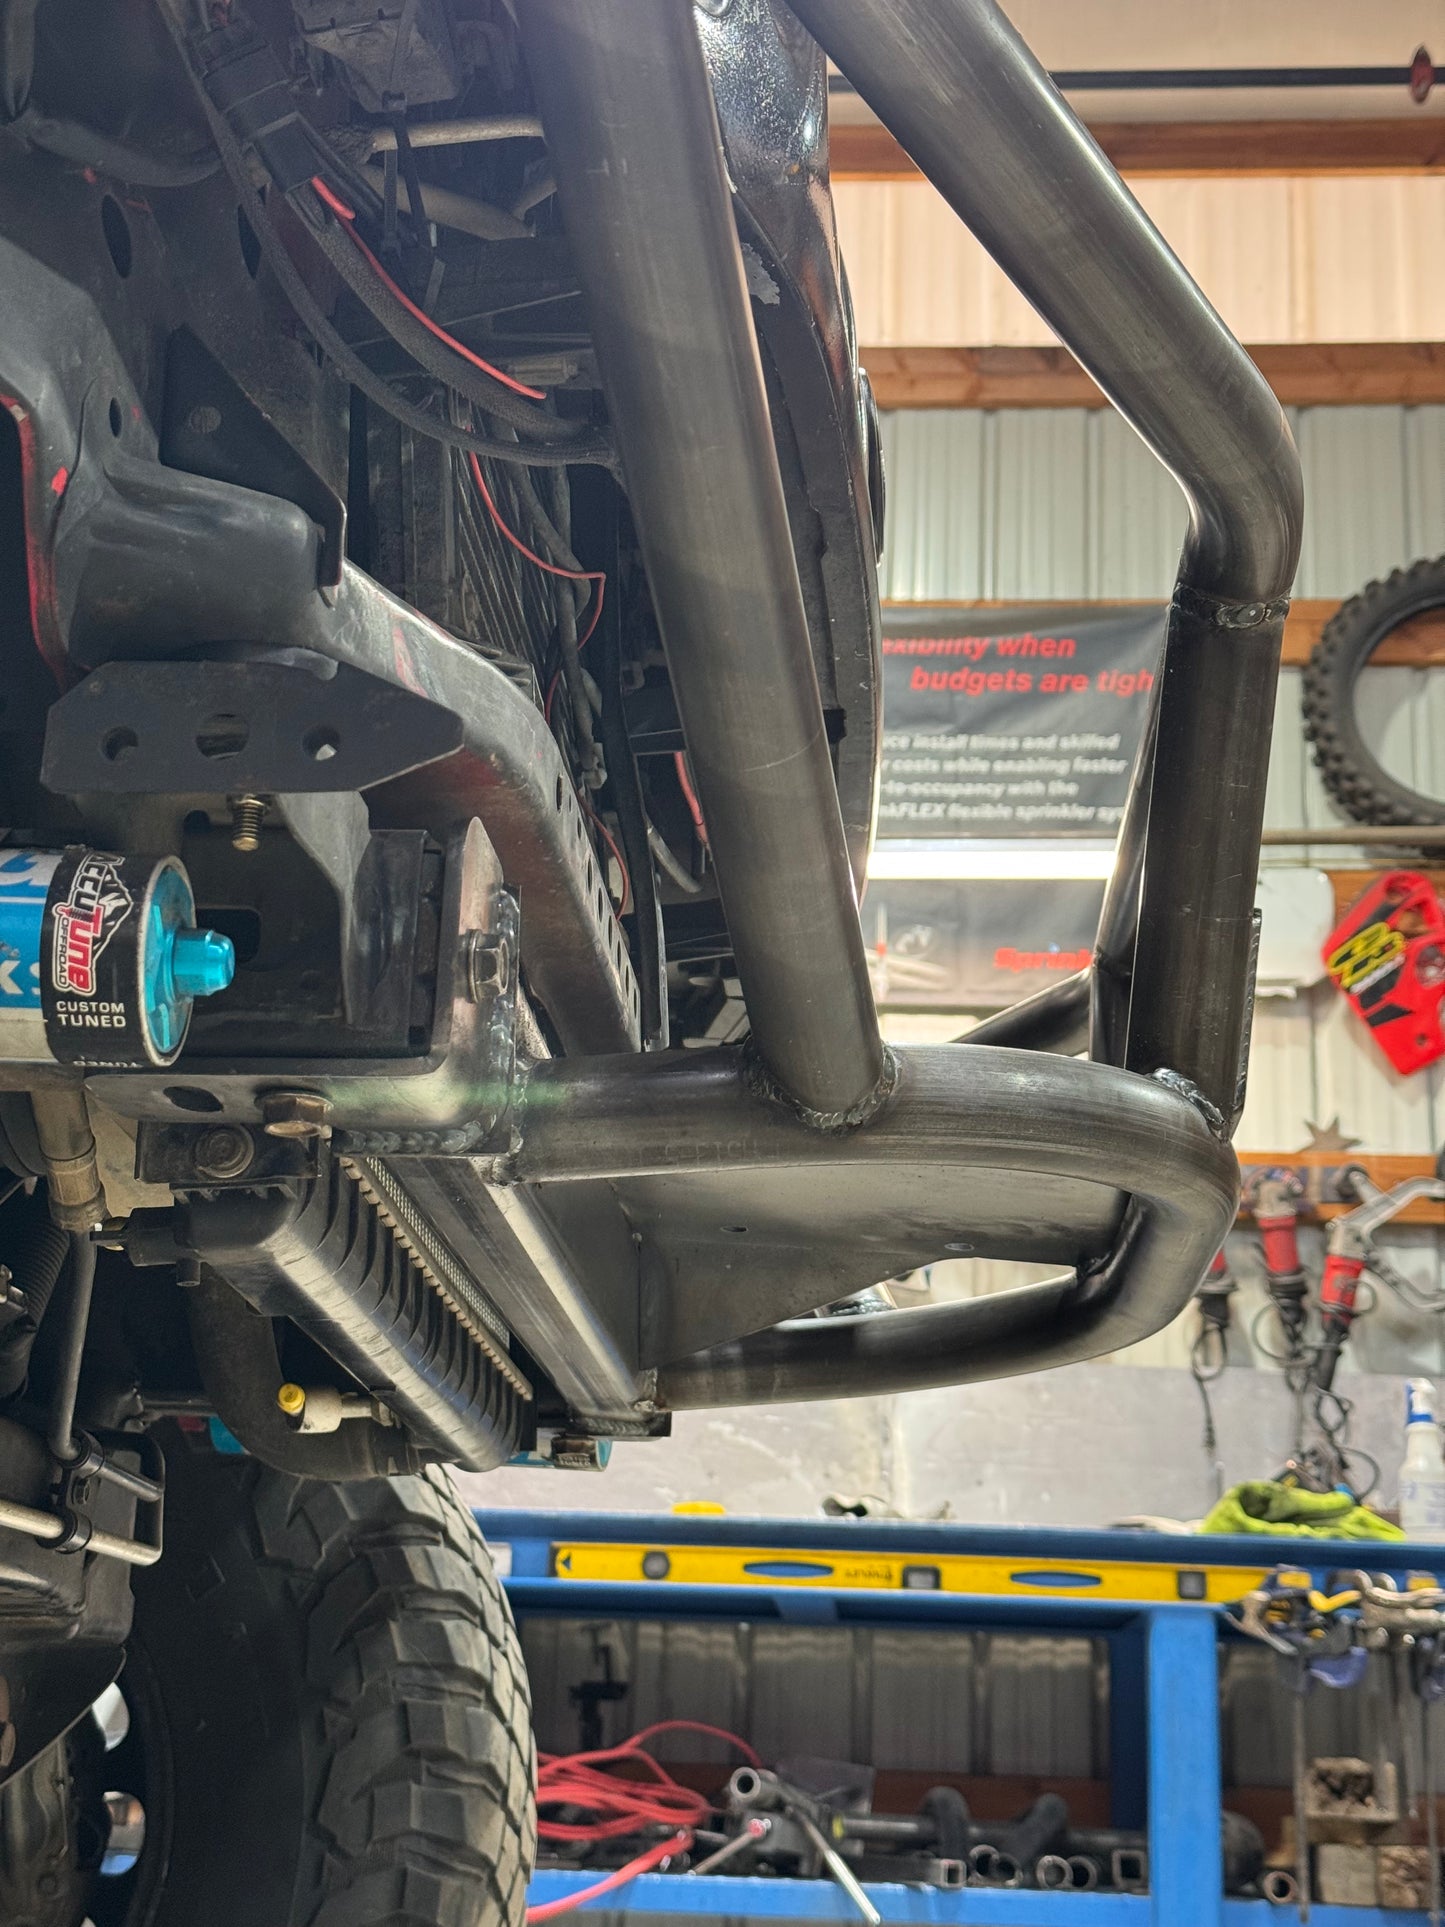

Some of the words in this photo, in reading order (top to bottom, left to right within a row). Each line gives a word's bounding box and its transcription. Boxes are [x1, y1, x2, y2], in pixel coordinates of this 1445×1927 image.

[997, 632, 1076, 658] when
[910, 666, 1032, 697] budgets
[1039, 673, 1089, 693] are
[1022, 733, 1058, 750] and
[1060, 732, 1121, 750] skilled
[942, 756, 990, 772] while
[992, 756, 1071, 777] enabling
[1072, 755, 1128, 774] faster
[1007, 779, 1046, 797] with
[1047, 779, 1079, 797] the
[1015, 802, 1096, 824] sprinkler
[58, 915, 68, 987] OFFROAD
[56, 1000, 125, 1013] CUSTOM
[57, 1013, 127, 1028] TUNED
